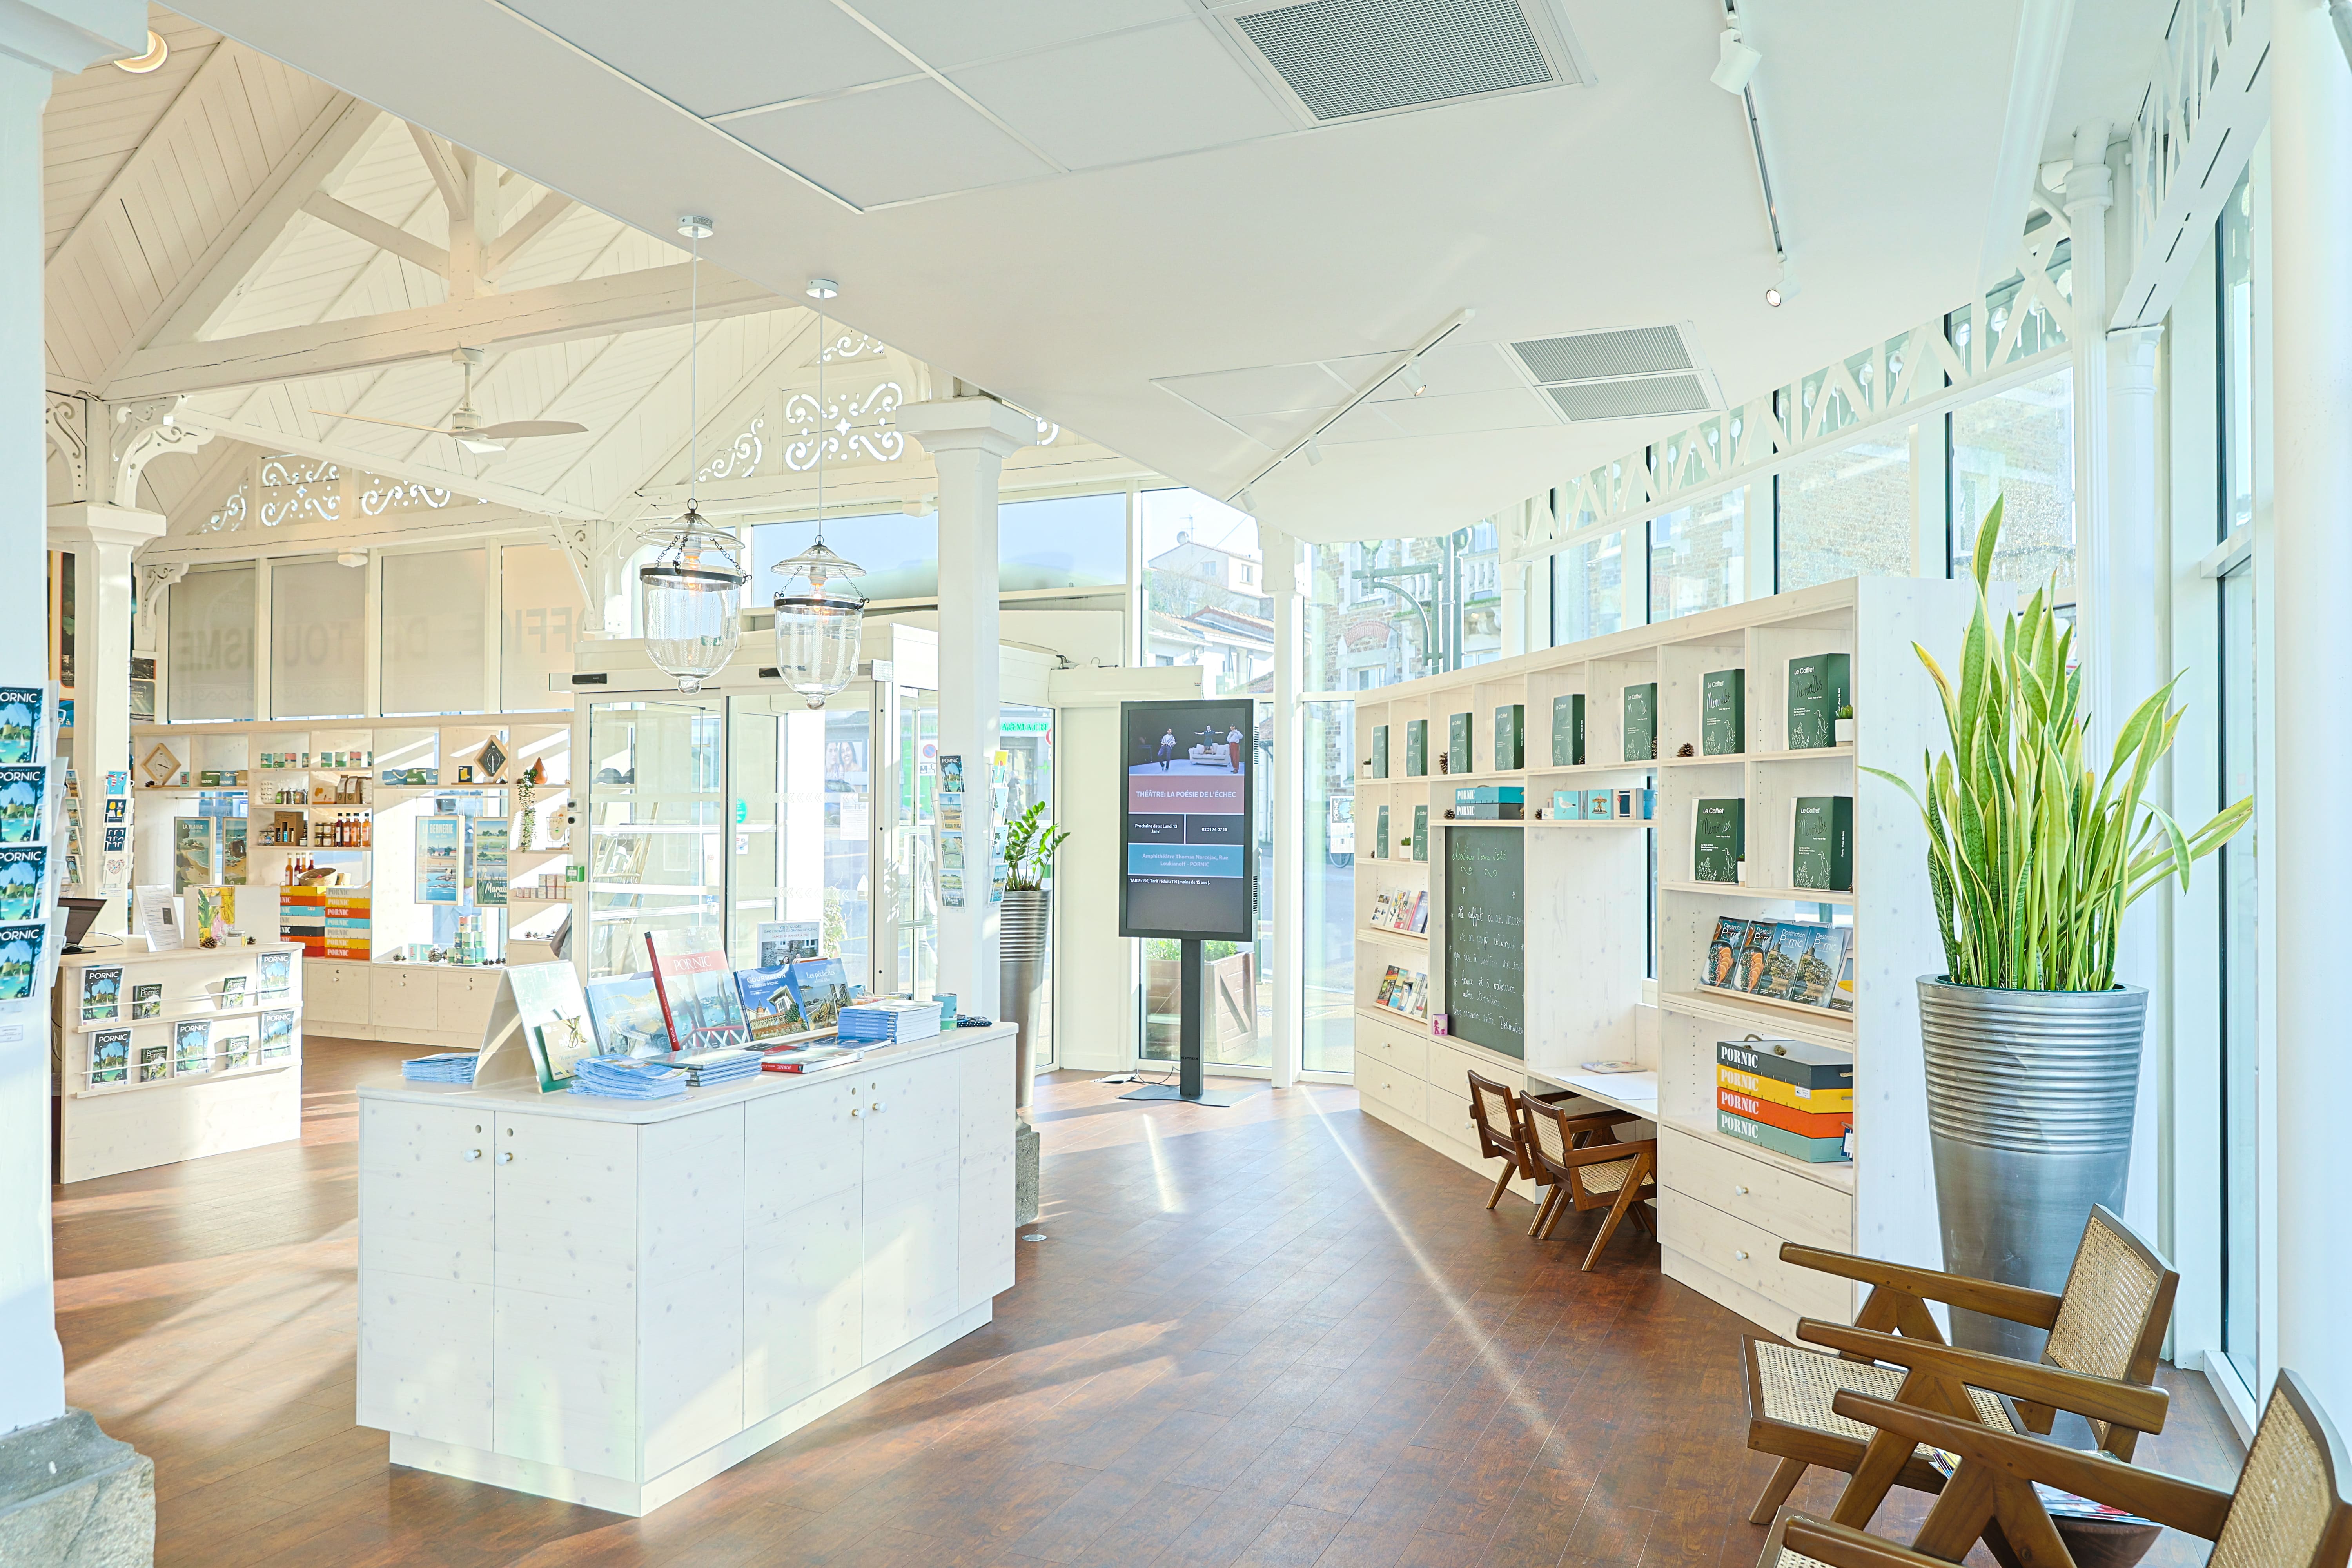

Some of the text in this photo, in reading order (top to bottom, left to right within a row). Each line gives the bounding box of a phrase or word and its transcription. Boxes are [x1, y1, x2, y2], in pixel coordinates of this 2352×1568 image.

[0, 692, 37, 703] ORNIC
[1000, 722, 1049, 731] ARMACIE
[1457, 790, 1475, 800] PORNIC
[1457, 806, 1475, 815] PORNIC
[430, 824, 454, 834] BERNERIE
[1458, 906, 1464, 919] Le
[1724, 922, 1742, 931] Destination
[0, 929, 39, 941] ORNIC
[1753, 933, 1769, 943] Porn
[1781, 929, 1805, 938] Destination
[1816, 933, 1838, 941] Destination
[1779, 935, 1803, 947] Pornic
[1813, 938, 1837, 952] Pornic
[673, 956, 711, 971] PORNIC
[89, 971, 119, 979] PORNIC
[747, 973, 786, 983] GOURMALON
[815, 969, 835, 980] pêcheries
[180, 1024, 207, 1033] PORNIC
[98, 1034, 127, 1043] PORNIC
[1721, 1046, 1758, 1069] PORNIC
[1721, 1068, 1759, 1092] PORNIC
[1721, 1091, 1759, 1115] PORNIC
[1721, 1114, 1758, 1139] PORNIC
